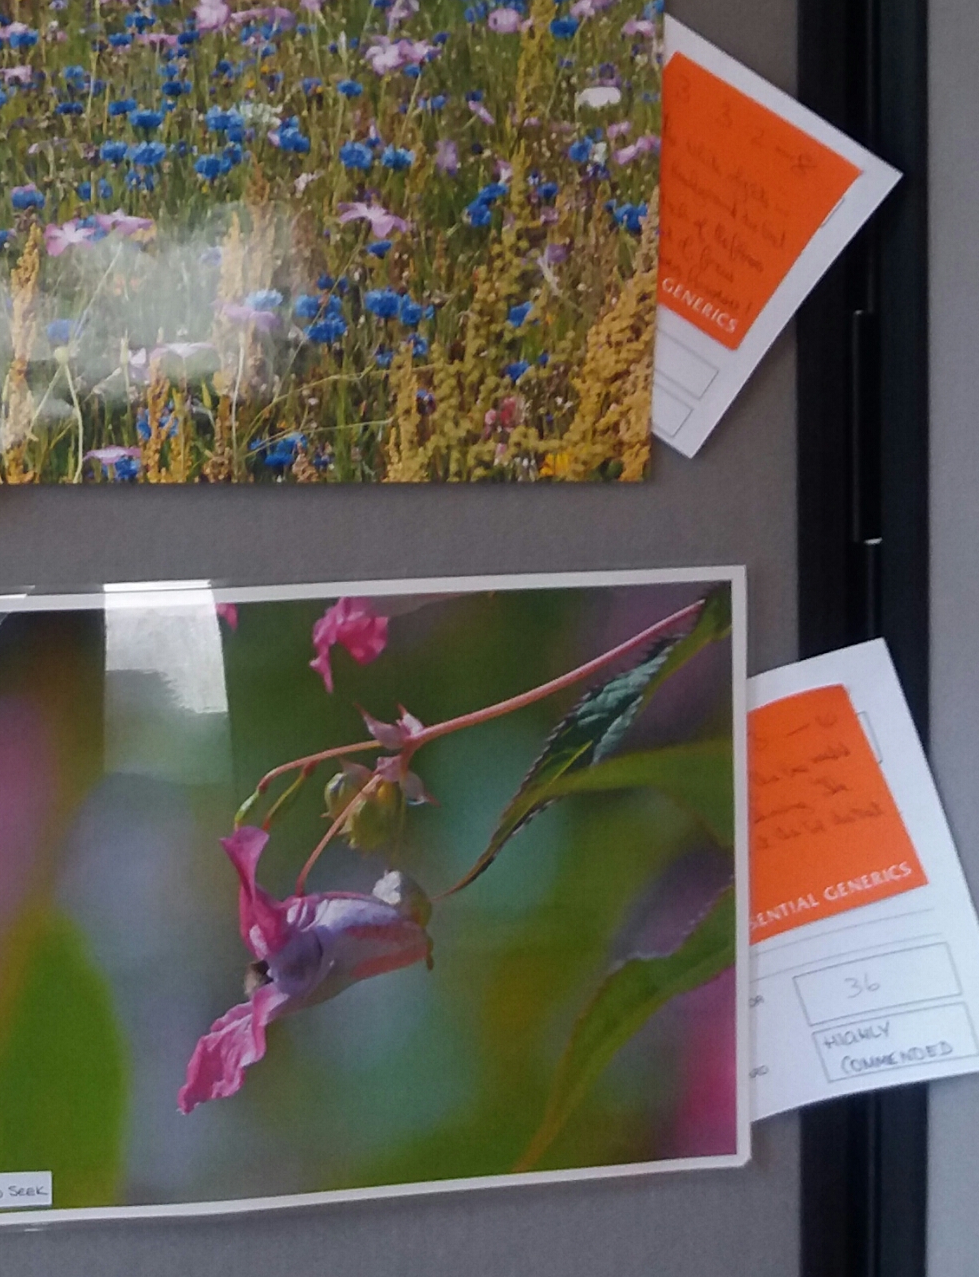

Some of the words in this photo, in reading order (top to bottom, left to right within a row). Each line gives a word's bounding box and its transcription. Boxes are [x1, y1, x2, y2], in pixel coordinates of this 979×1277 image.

[661, 276, 740, 335] GENERICS
[823, 861, 913, 902] GENERICS
[844, 973, 881, 999] 36
[840, 1040, 954, 1074] COMMENDED
